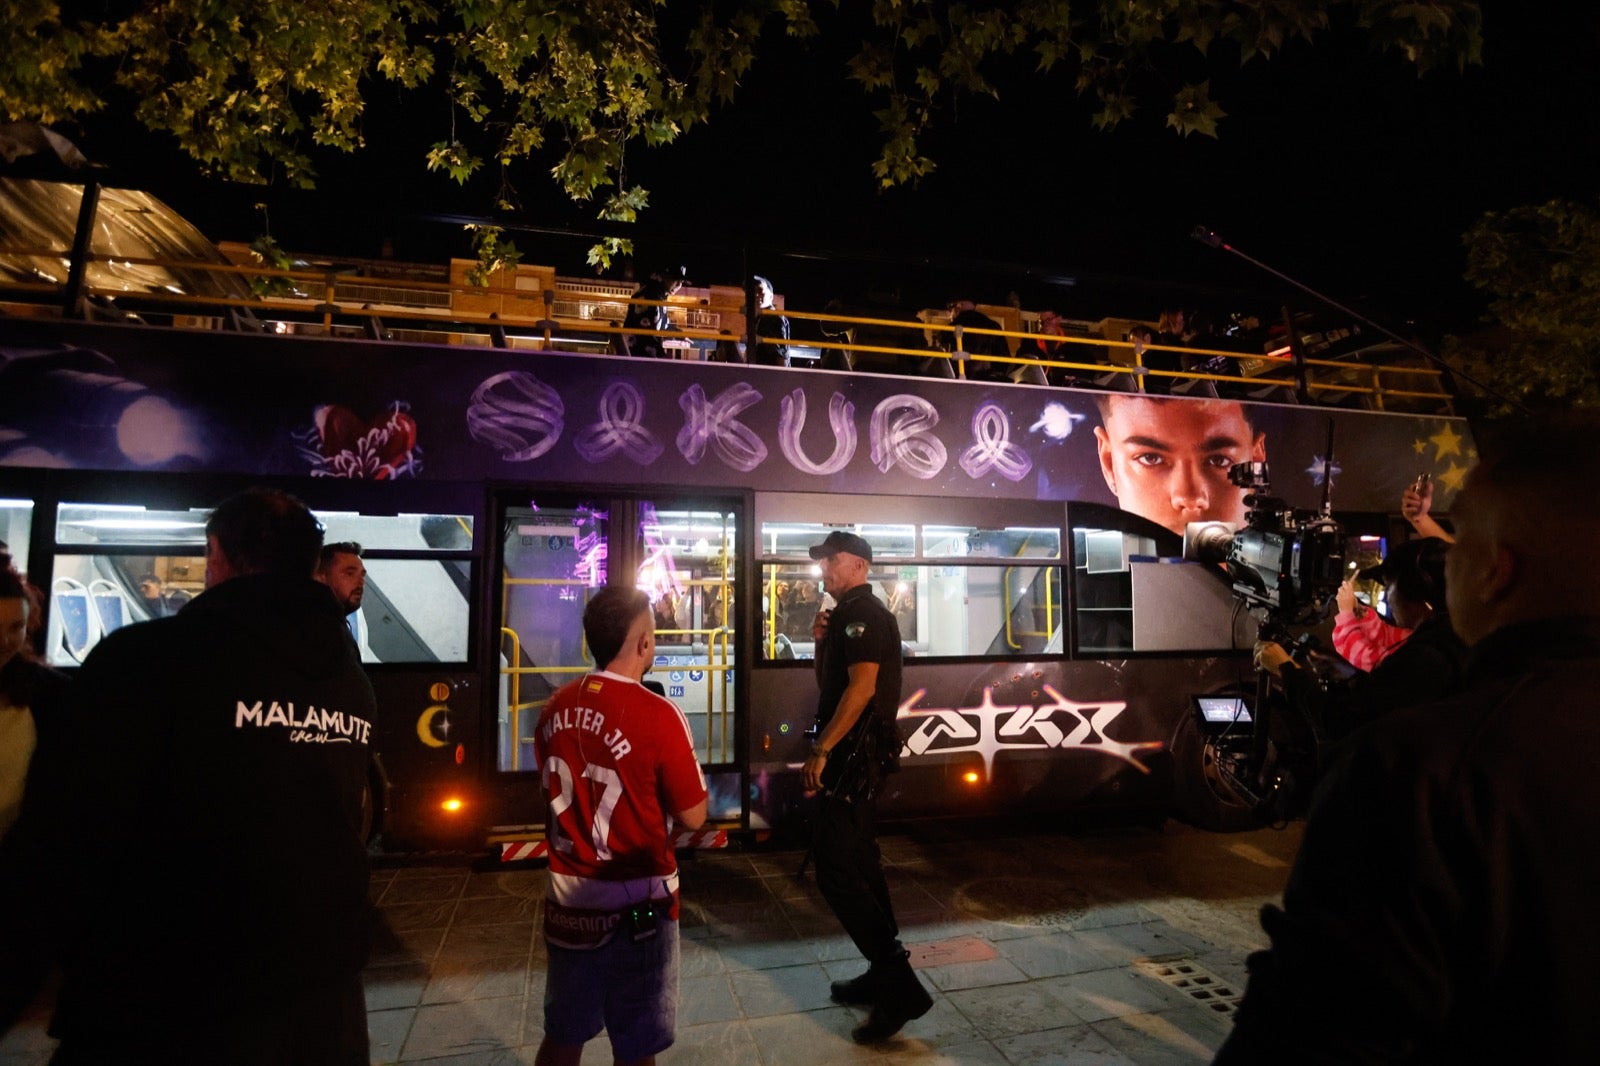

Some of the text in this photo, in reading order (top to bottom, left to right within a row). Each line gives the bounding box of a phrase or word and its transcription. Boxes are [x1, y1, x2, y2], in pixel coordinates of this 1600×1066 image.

[467, 371, 1032, 482] SAKURA
[235, 701, 372, 744] MALAMUTE
[290, 729, 351, 744] crew
[542, 707, 632, 761] WALTER JR
[542, 755, 623, 861] 27
